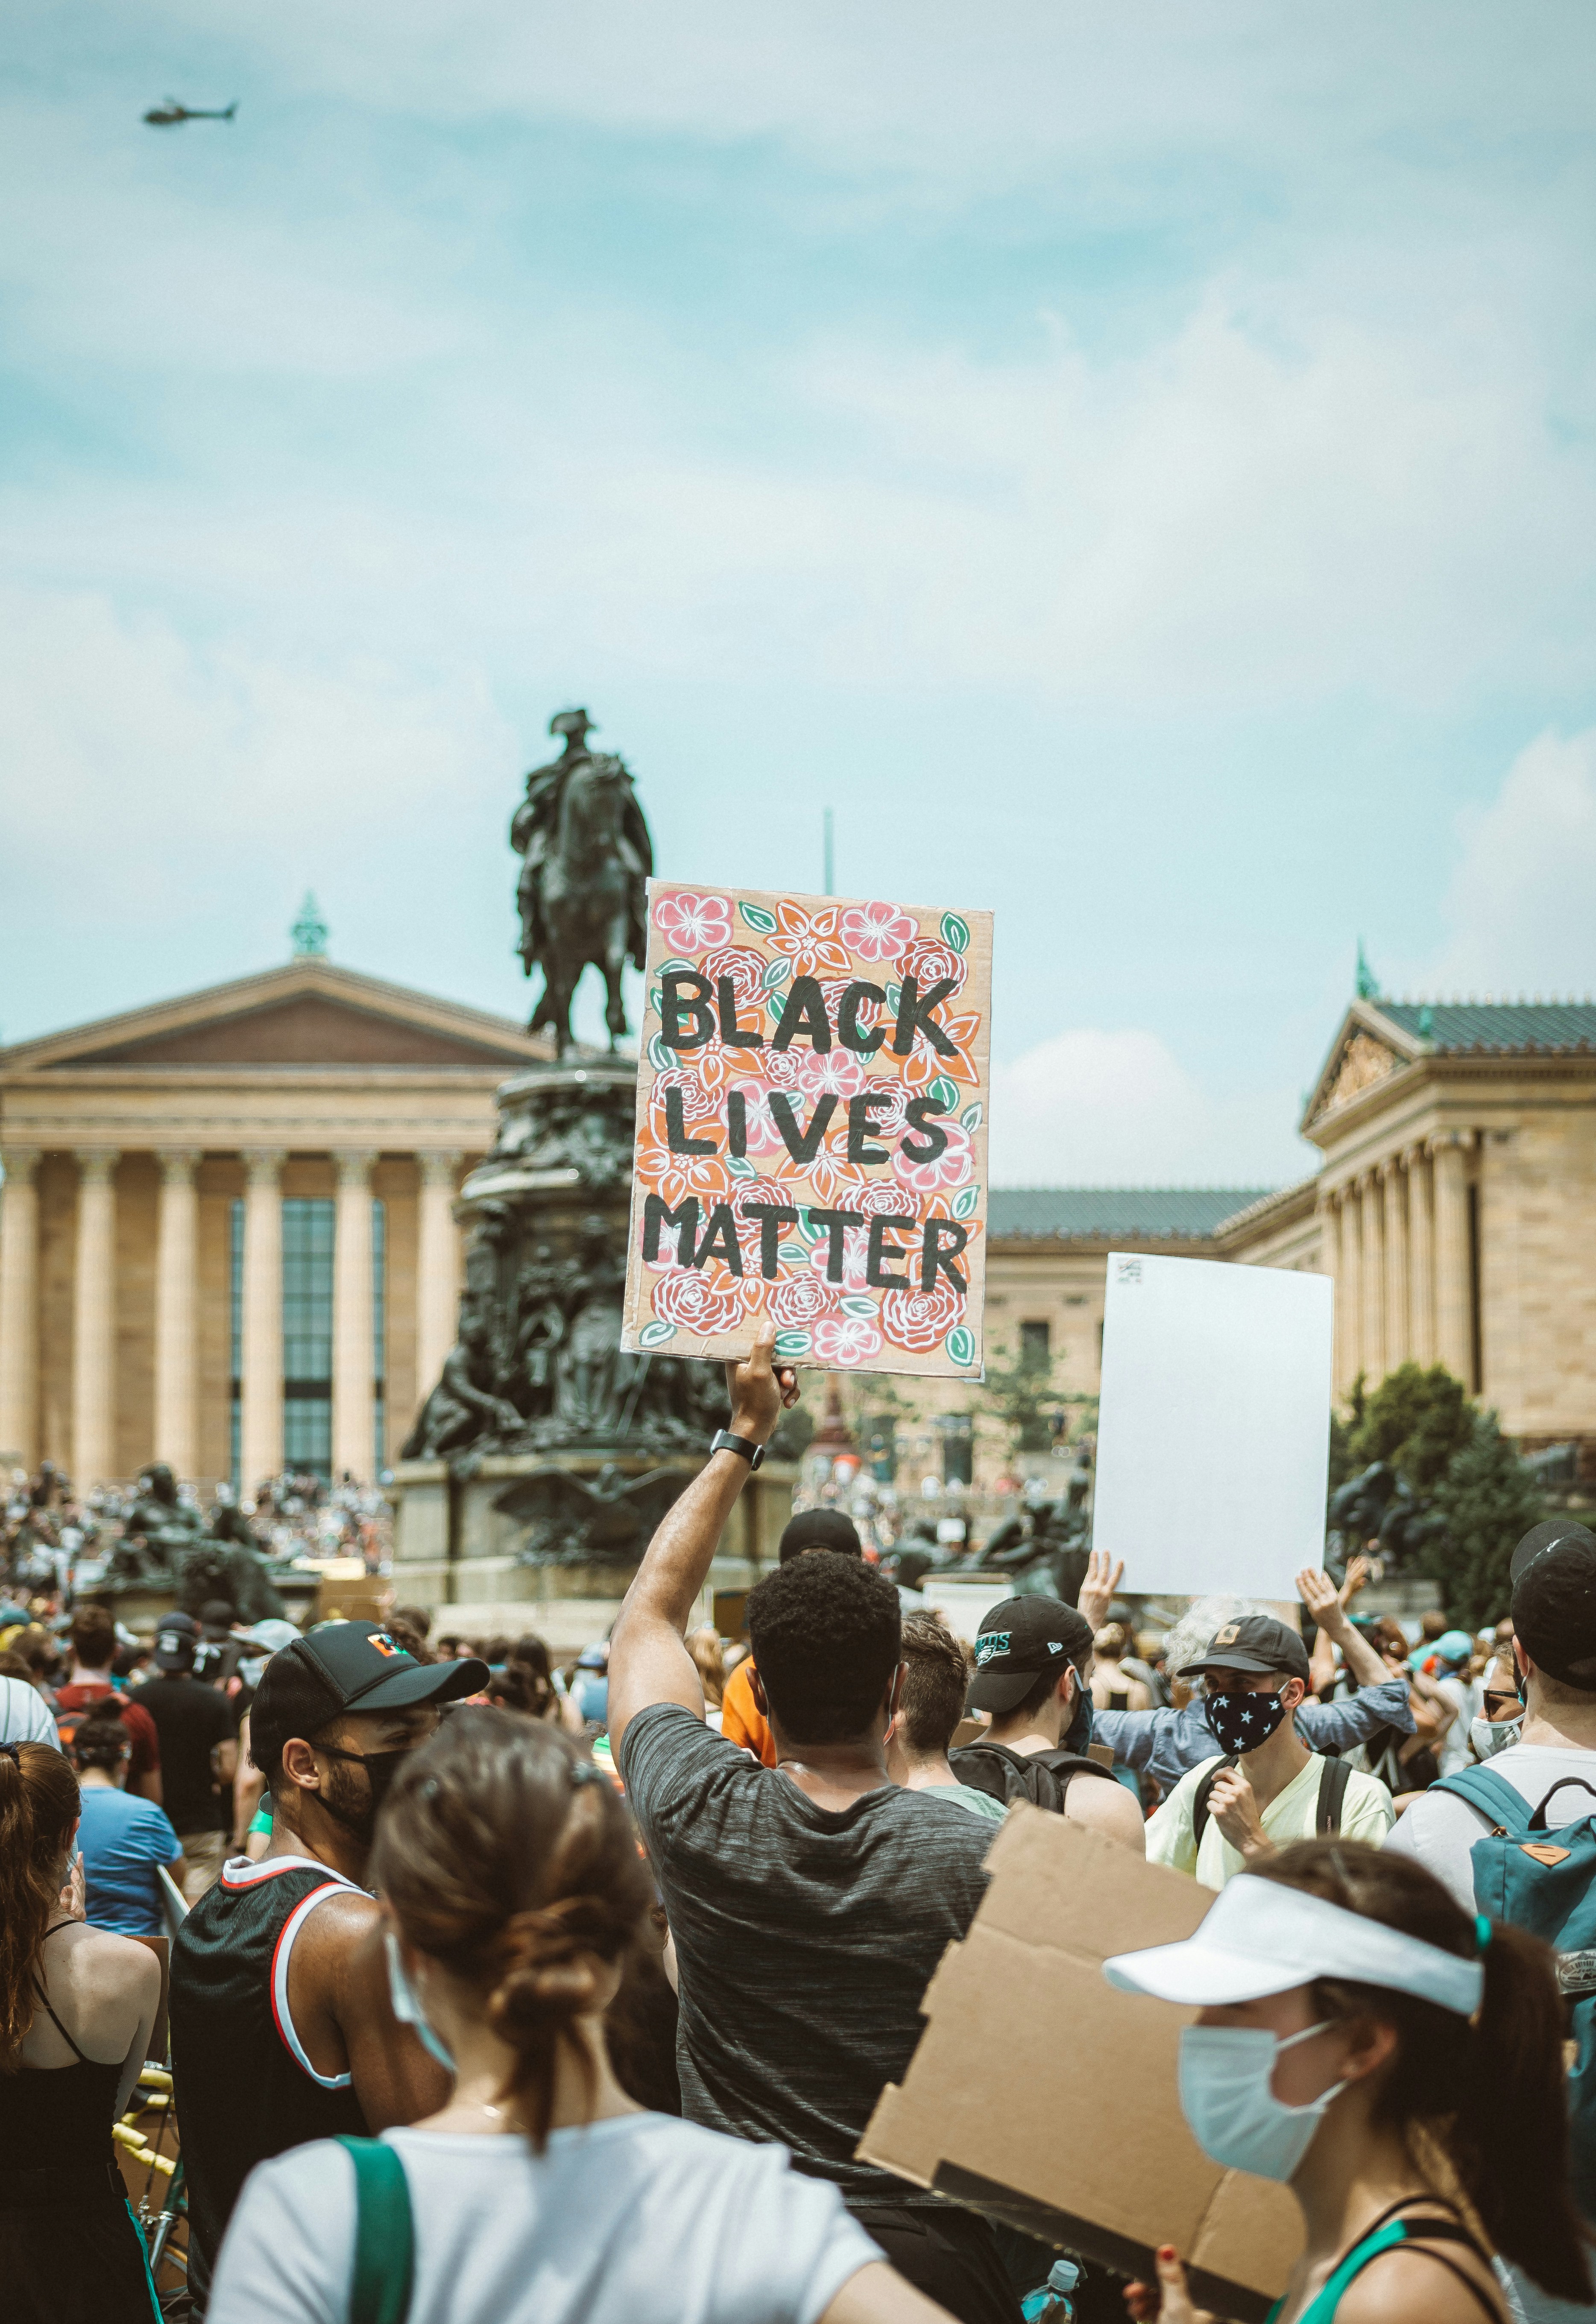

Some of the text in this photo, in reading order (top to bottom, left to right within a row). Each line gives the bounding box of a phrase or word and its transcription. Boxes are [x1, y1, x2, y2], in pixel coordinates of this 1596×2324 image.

[660, 970, 958, 1056] BLACK
[666, 1087, 949, 1164] LIVES
[642, 1194, 968, 1293] MATTER
